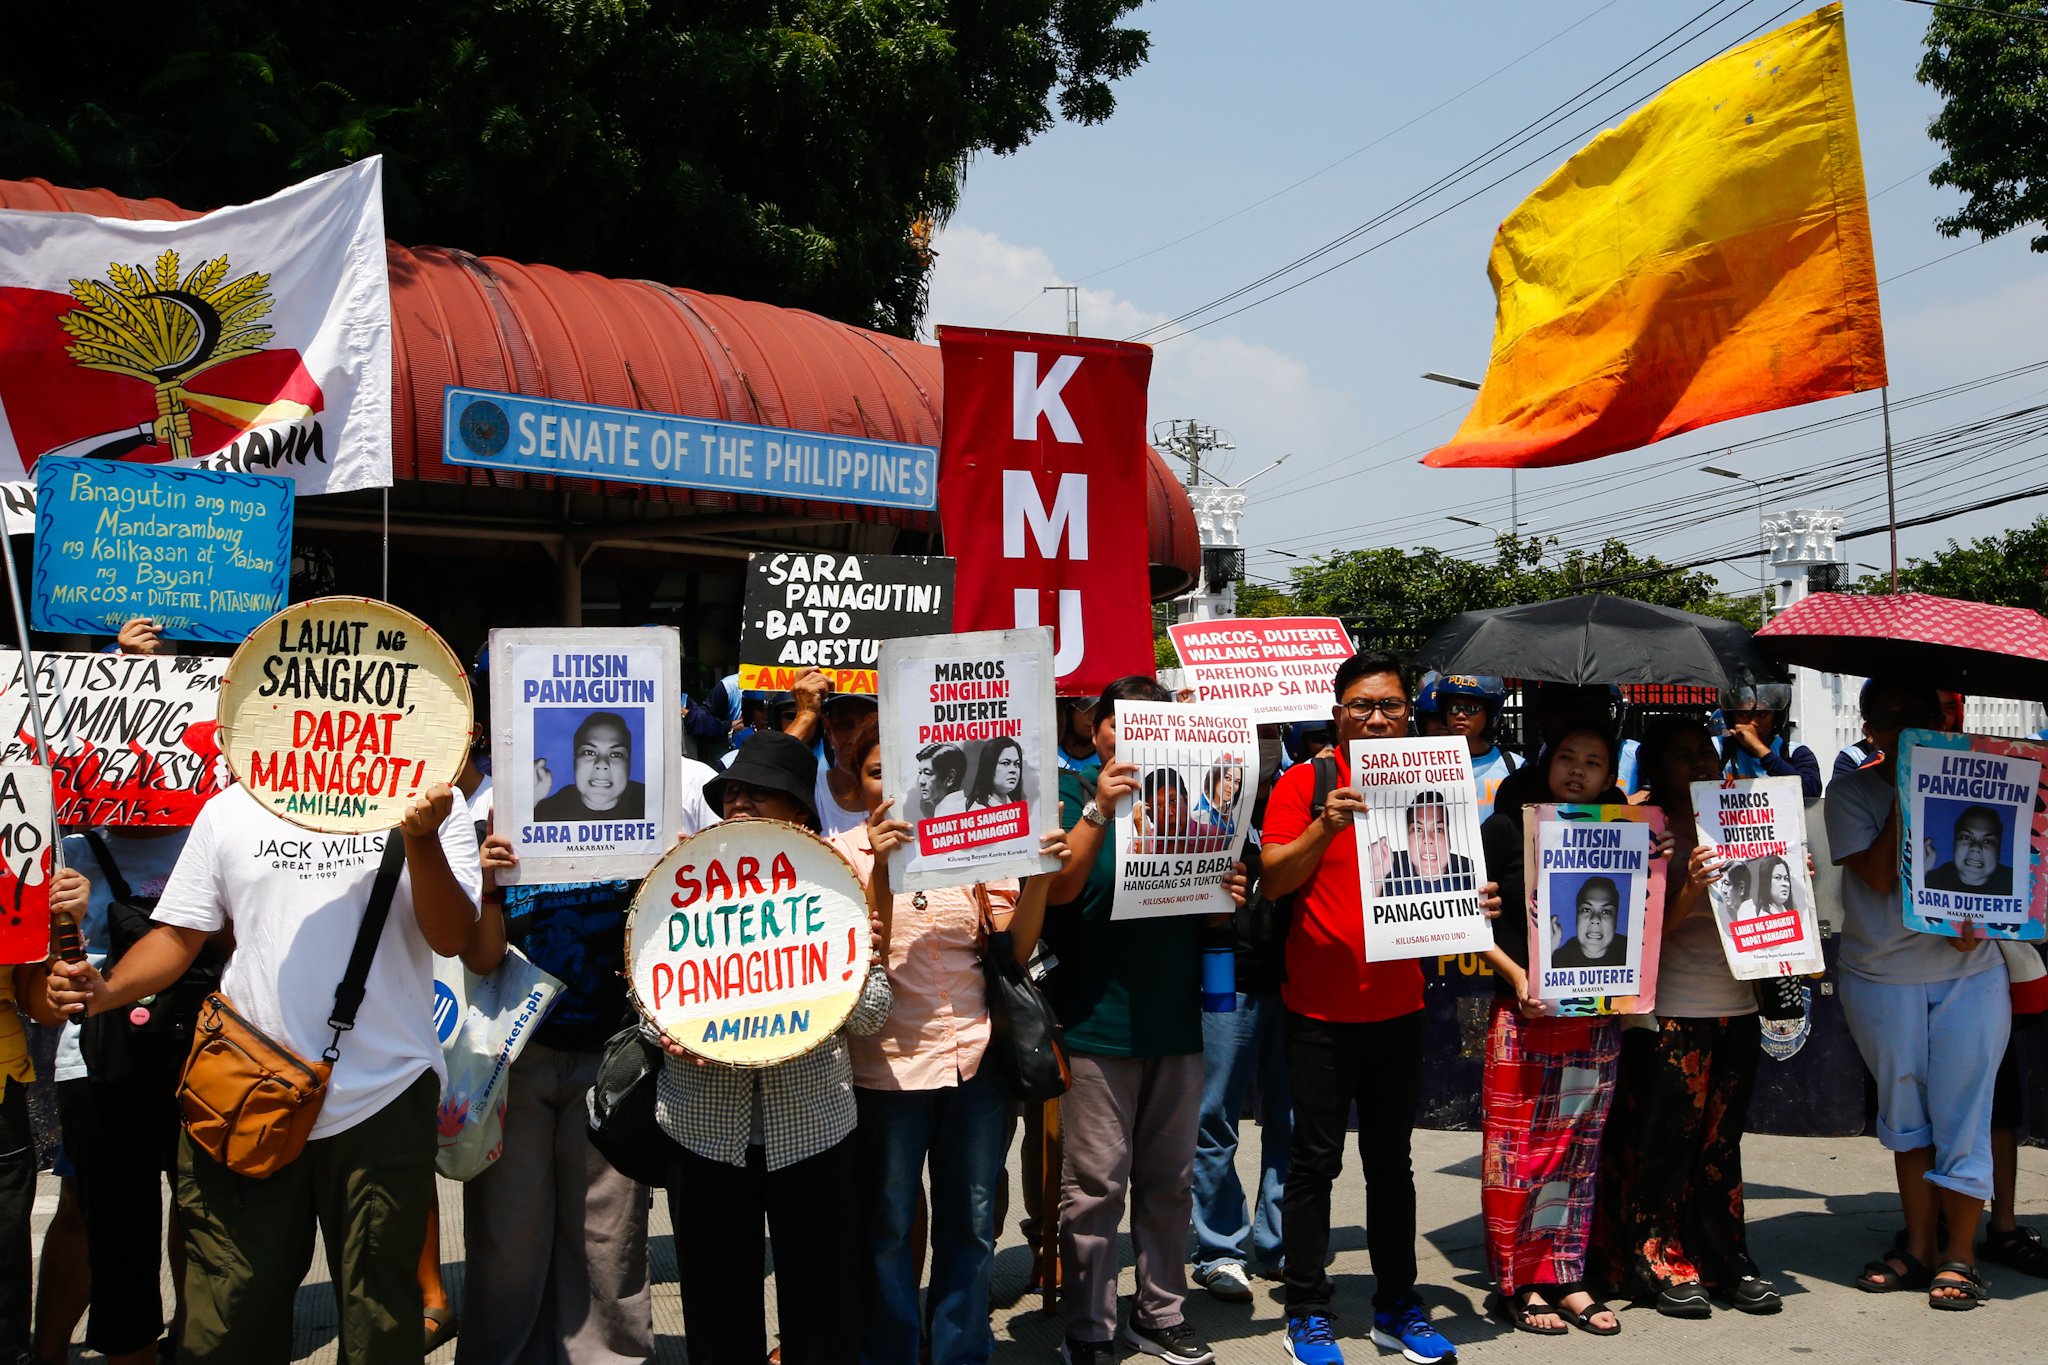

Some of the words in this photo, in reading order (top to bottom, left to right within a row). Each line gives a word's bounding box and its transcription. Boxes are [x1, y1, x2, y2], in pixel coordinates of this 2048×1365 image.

[518, 411, 640, 467] SENATE
[650, 428, 689, 472] OF
[701, 435, 754, 479] THE
[766, 442, 928, 497] PHILIPPINES
[70, 473, 186, 512] Panagutin
[195, 494, 225, 515] ang
[230, 499, 266, 522] mga
[95, 507, 242, 551] Mandarambong
[62, 541, 84, 559] ng
[91, 537, 188, 563] Kalikasan
[197, 544, 215, 563] at
[225, 547, 274, 573] Kaban
[96, 566, 116, 584] ng
[136, 563, 213, 591] Bayan!
[51, 584, 128, 604] MARCOS
[130, 592, 143, 602] AT
[209, 589, 282, 613] PATALSIKIN!
[786, 584, 942, 615] PANAGUTIN!
[279, 619, 368, 656] LAHAT
[376, 630, 408, 651] NG
[1183, 630, 1262, 647] MARCOS,
[1263, 629, 1340, 643] DUTERTE
[1187, 646, 1260, 662] WALANG
[1263, 642, 1347, 659] PINAG-IBA
[553, 654, 628, 678] LITISIN
[935, 661, 1005, 682] MARCOS
[1196, 665, 1278, 681] PAREHONG
[259, 655, 419, 715] SANGKOT,
[524, 680, 654, 703] PANAGUTIN
[929, 680, 1010, 702] SINGILIN!
[1199, 682, 1274, 701] PAHIRAP
[1278, 681, 1302, 696] SA
[1448, 676, 1478, 687] PULIS
[13, 692, 193, 747] TUMINDIG
[934, 701, 1008, 723] DUTERTE
[1123, 712, 1163, 727] LAHAT
[1168, 715, 1185, 728] NG
[1189, 716, 1249, 729] SANGKOT
[293, 710, 402, 755] DAPAT
[919, 719, 1022, 744] PANAGUTIN!
[1124, 727, 1170, 741] DAPAT
[1175, 729, 1251, 744] MANAGOT!
[1361, 753, 1399, 770] SARA
[1402, 750, 1462, 769] DUTERTE
[1941, 756, 2008, 780] LITISIN
[250, 751, 425, 798] MANAGOT!
[1361, 770, 1421, 787] KURAKOT
[1425, 768, 1464, 785] QUEEN
[1917, 774, 2030, 803] PANAGUTIN
[1719, 793, 1769, 809] MARCOS
[926, 821, 957, 835] LAHAT
[960, 817, 974, 829] NG
[976, 808, 1021, 826] SANGKOT
[1718, 809, 1775, 826] SINGILIN!
[522, 825, 571, 844] SARA
[579, 823, 655, 842] DUTERTE
[932, 833, 965, 848] DAPAT
[967, 825, 1018, 842] MANAGOT!
[1563, 829, 1621, 848] LITISIN
[1723, 826, 1775, 843] DUTERTE
[254, 840, 312, 859] JACK
[322, 836, 385, 857] WILLS
[567, 844, 615, 852] MAKABAYAN
[1716, 841, 1787, 860] PANAGUTIN!
[272, 860, 312, 871] GREAT
[318, 856, 365, 871] BRITAIN
[1124, 859, 1170, 878] MULA
[1174, 859, 1193, 876] SA
[1197, 856, 1233, 875] BABA
[1543, 850, 1641, 870] PANAGUTIN
[316, 872, 337, 880] 1999
[671, 851, 796, 908] SARA
[1123, 879, 1177, 892] HANGGANG
[1179, 878, 1191, 888] SA
[1194, 875, 1224, 887] TUKTO
[1143, 894, 1175, 906] KILUSANG
[1176, 893, 1194, 905] MAYO
[1195, 893, 1209, 901] UNO
[1918, 890, 1950, 908] SARA
[1954, 895, 2022, 913] DUTERTE
[669, 893, 825, 952] DUTERTE
[1373, 898, 1481, 925] PANAGUTIN!
[1734, 923, 1754, 936] LAHAT
[1766, 916, 1795, 930] SANGKOT
[1396, 935, 1430, 945] KILUSANG
[1430, 933, 1450, 943] MAYO
[1452, 932, 1466, 941] UNO
[1741, 936, 1761, 948] DAPAT
[1545, 970, 1575, 987] SARA
[1580, 969, 1633, 985] DUTERTE
[702, 1010, 810, 1043] AMIHAN
[484, 990, 544, 1099] smmarkets.ph
